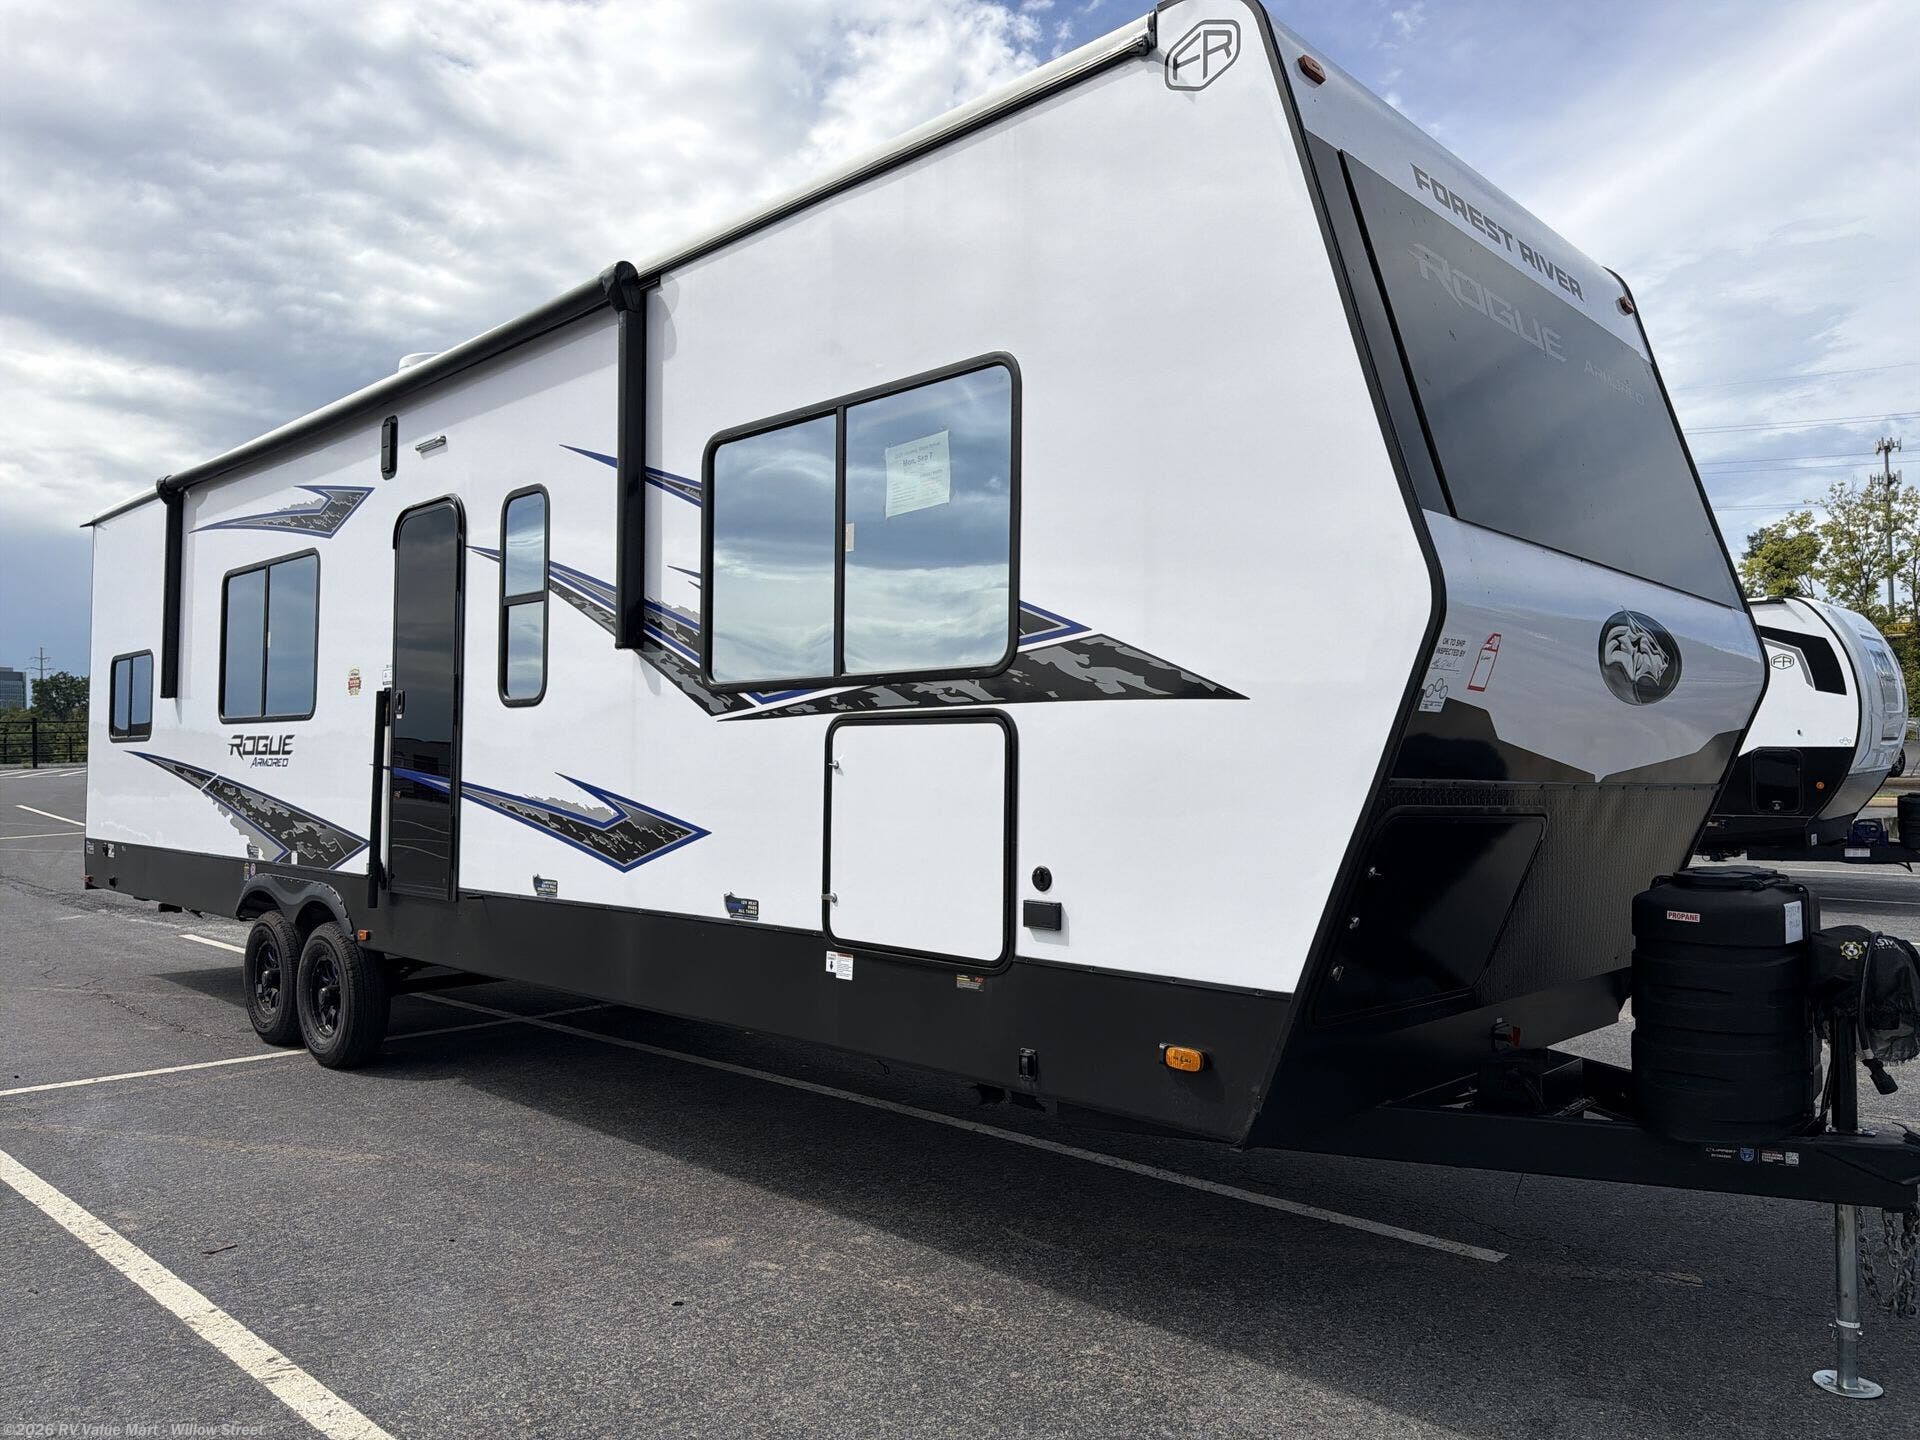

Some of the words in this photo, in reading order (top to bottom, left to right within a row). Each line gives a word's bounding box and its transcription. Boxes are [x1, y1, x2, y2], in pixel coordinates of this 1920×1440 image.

[1409, 162, 1514, 253] FOREST
[1516, 238, 1585, 302] RIVER
[1408, 243, 1568, 363] ROGUE
[228, 734, 296, 760] ROGUE
[250, 757, 289, 768] ARMORED
[1667, 911, 1700, 922] PROPANE
